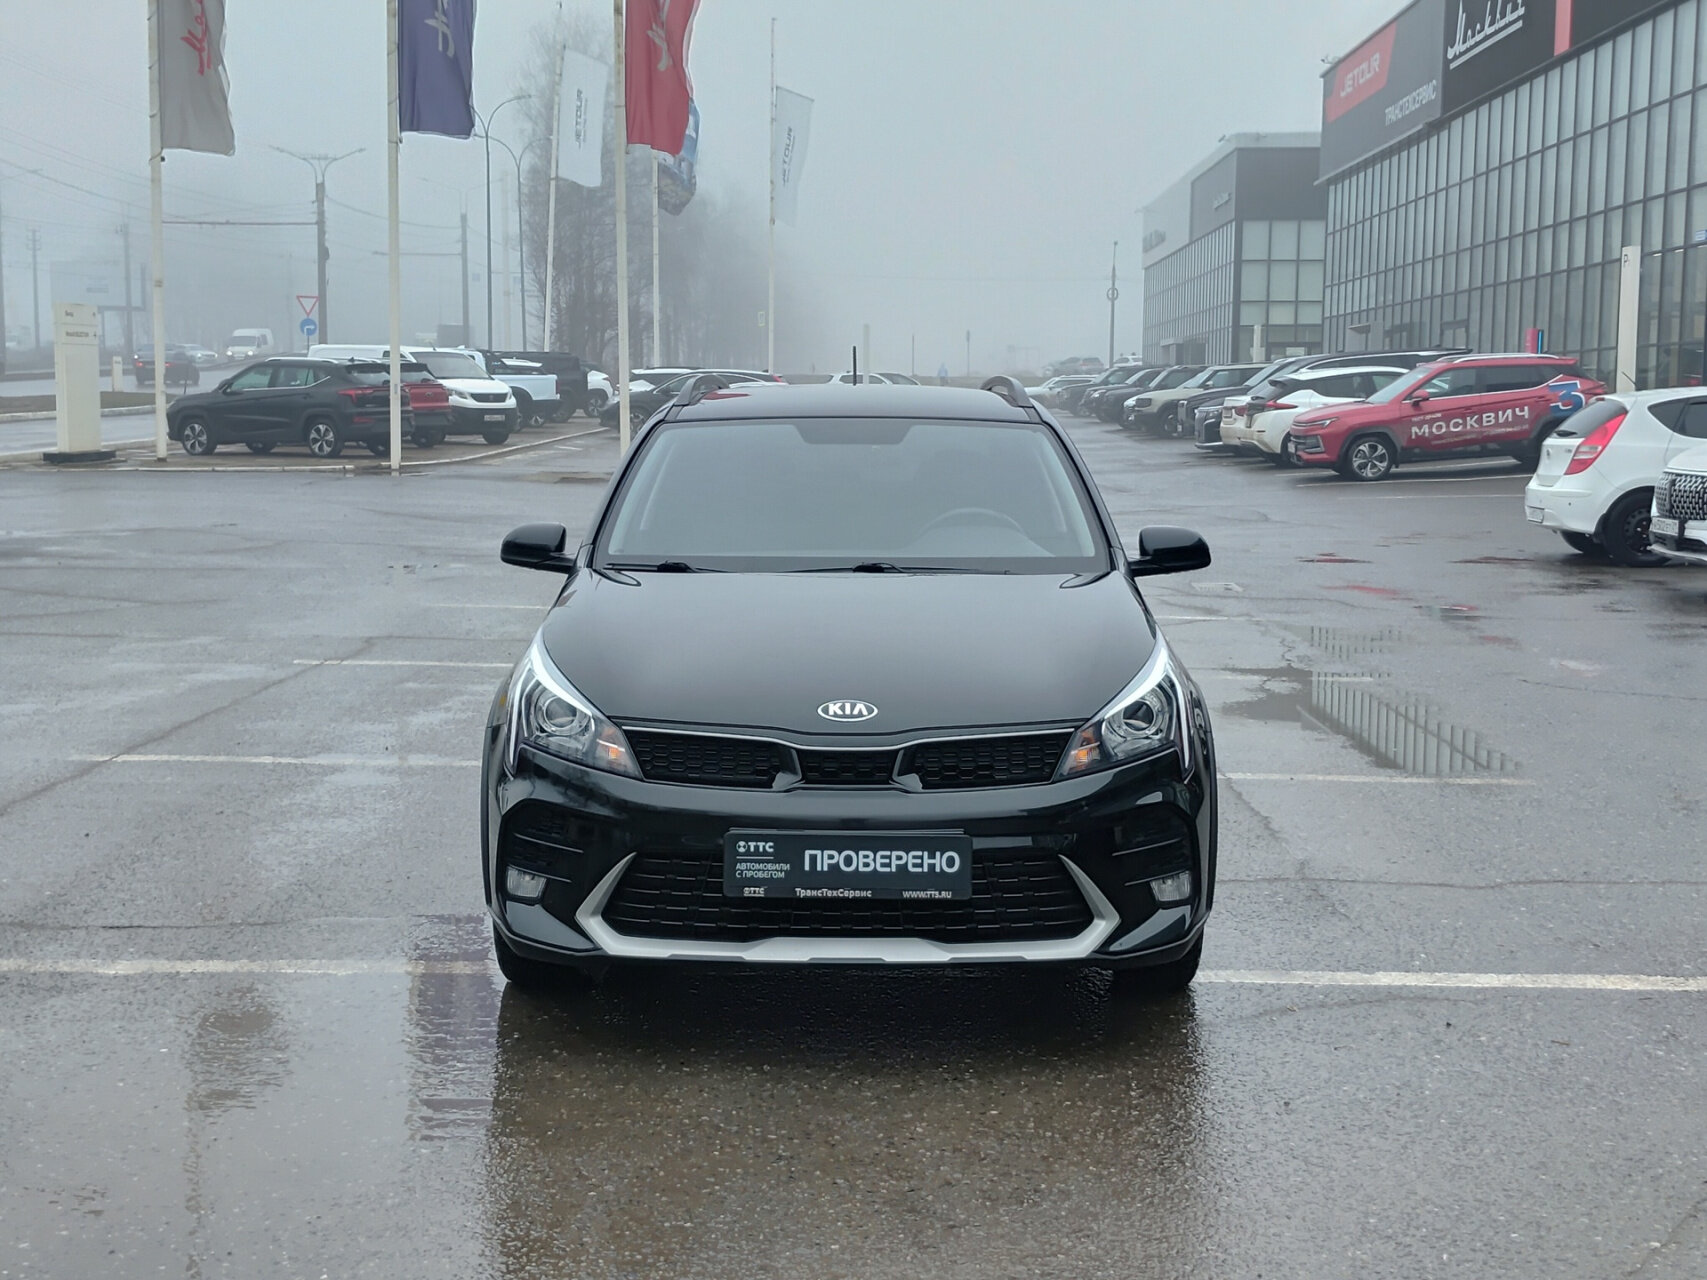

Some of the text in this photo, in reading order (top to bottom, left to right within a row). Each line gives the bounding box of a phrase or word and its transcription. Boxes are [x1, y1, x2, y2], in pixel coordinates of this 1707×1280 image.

[1340, 53, 1380, 97] JETOUR
[1384, 79, 1437, 126] ТРАНСТЕХСЕРВИС
[1411, 406, 1529, 439] МОСКВИЧ
[828, 702, 869, 716] KIA
[735, 862, 791, 871] АВТОМОБИЛИ
[804, 849, 961, 873] ПРОВЕРЕНО
[735, 870, 785, 879] С ПРОБЕГОМ
[795, 887, 872, 898] ТрансТехСервис
